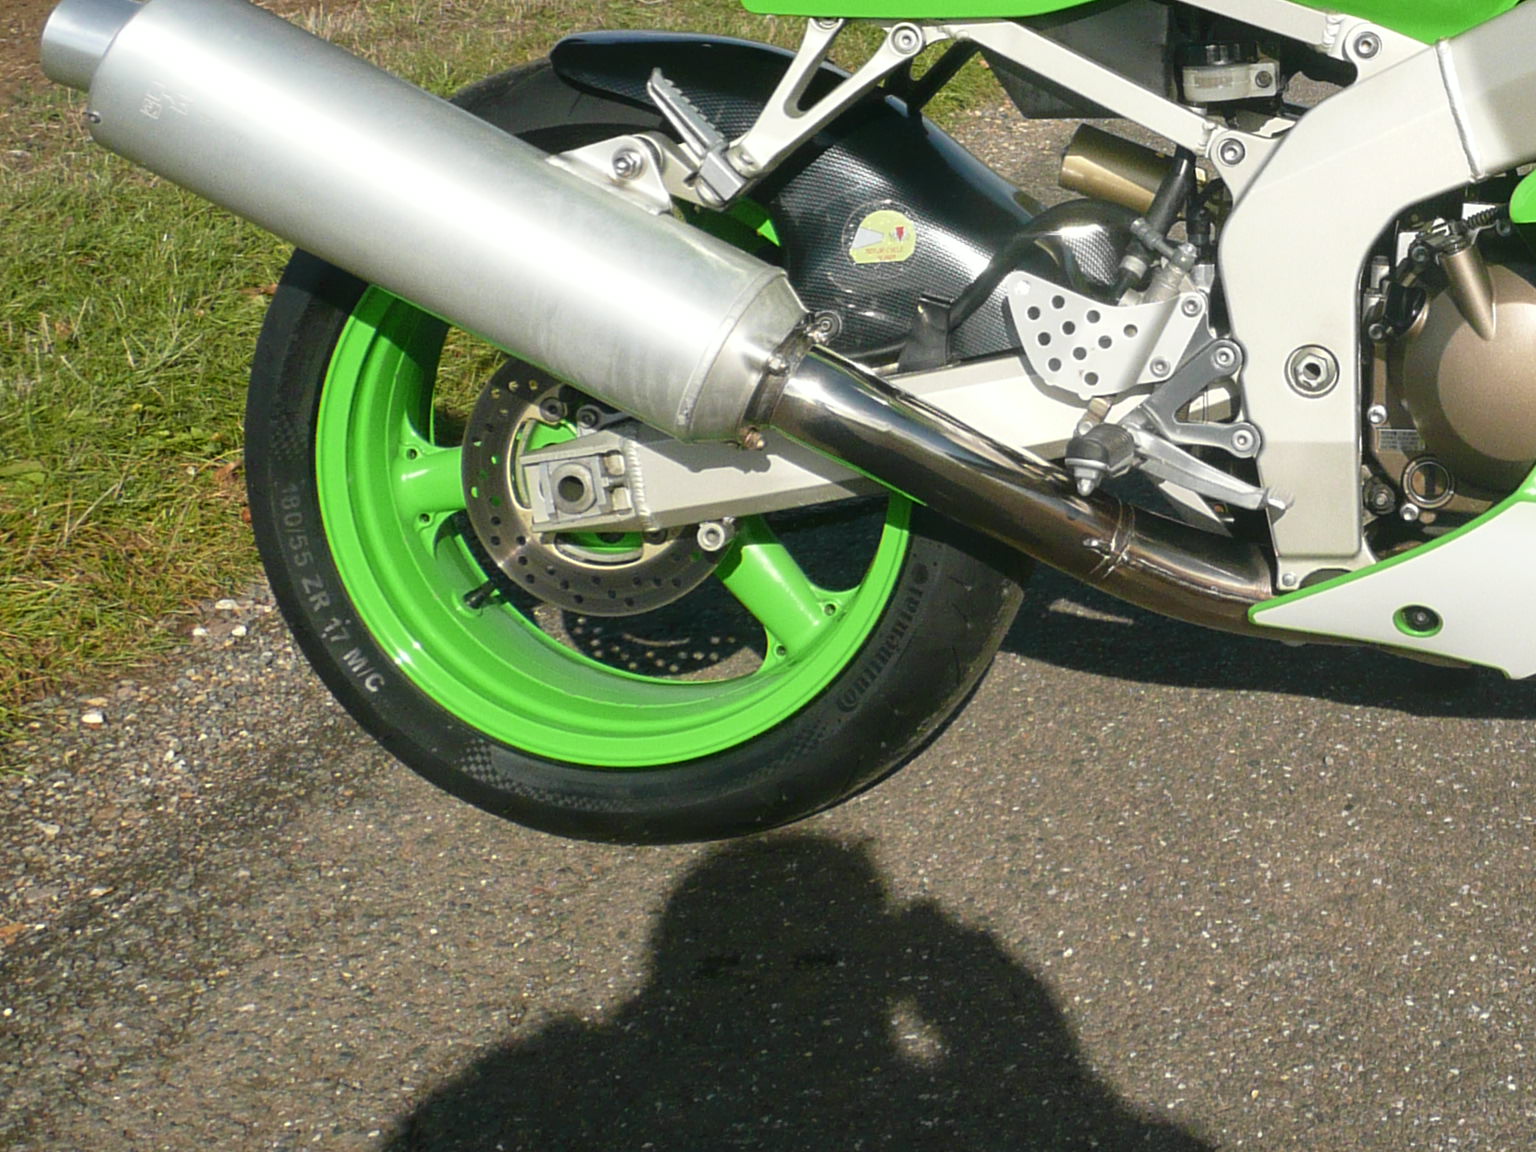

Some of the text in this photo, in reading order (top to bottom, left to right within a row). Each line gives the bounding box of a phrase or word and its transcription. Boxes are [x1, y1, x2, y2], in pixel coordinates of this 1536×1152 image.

[281, 484, 314, 568] 180/55
[301, 574, 332, 612] ZR
[342, 647, 386, 694] M/C
